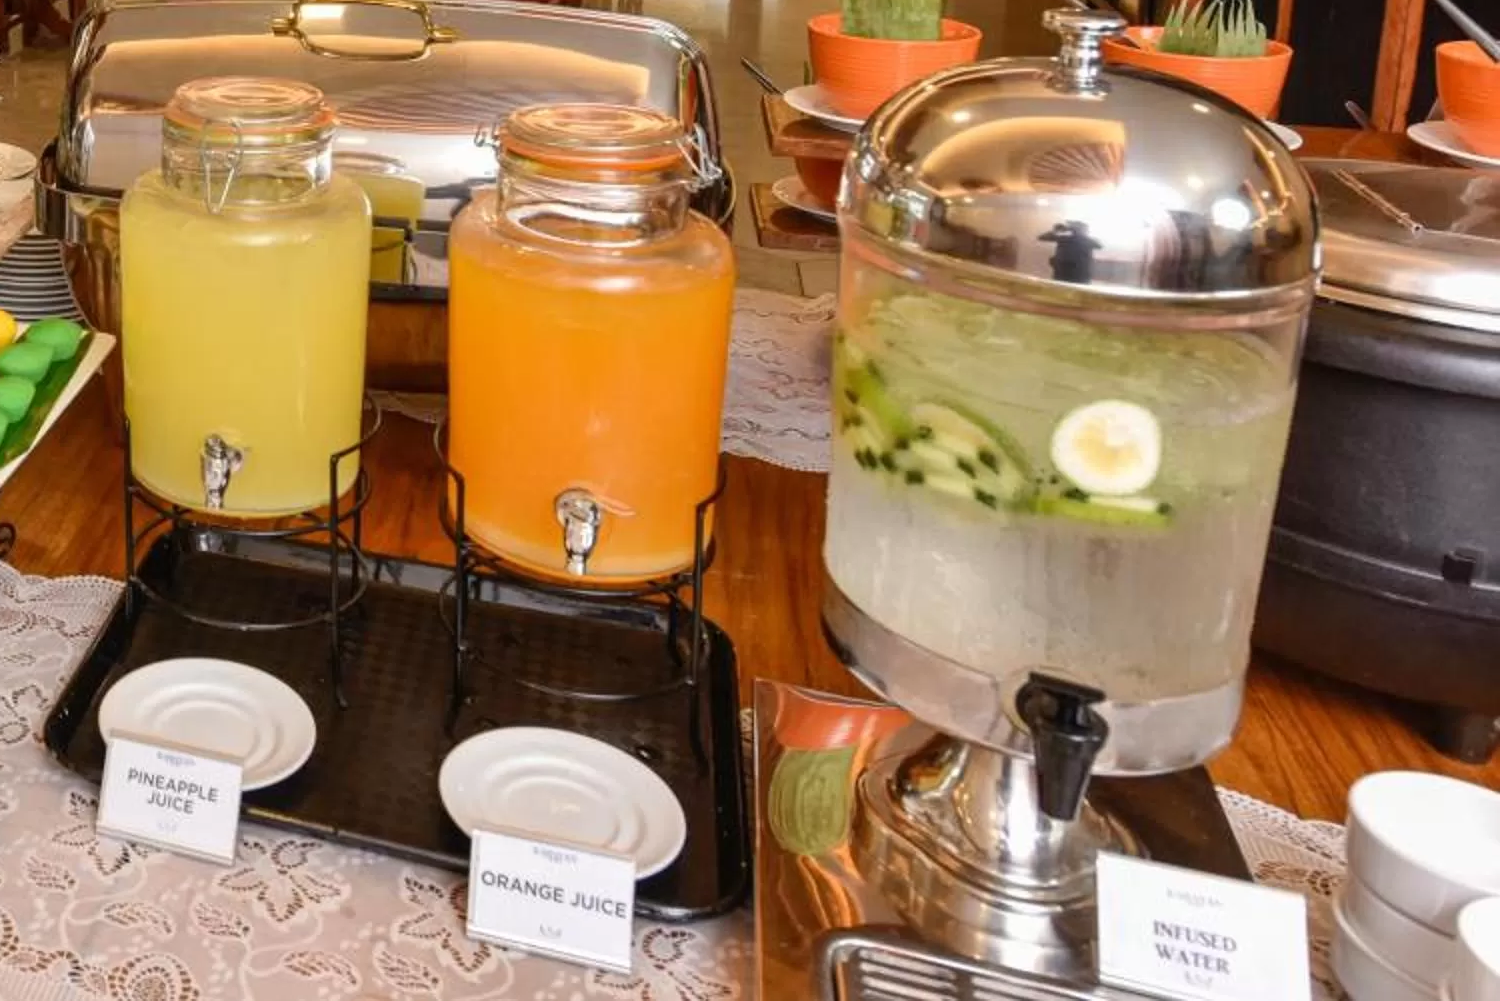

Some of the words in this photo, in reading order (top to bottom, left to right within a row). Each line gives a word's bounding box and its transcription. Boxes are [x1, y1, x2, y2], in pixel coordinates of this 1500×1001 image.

[127, 767, 219, 802] PINEAPPLE
[147, 790, 195, 815] JUICE
[481, 870, 565, 904] ORANGE
[569, 892, 627, 919] JUICE
[1152, 919, 1237, 952] INFUSED
[1153, 943, 1231, 975] WATER
